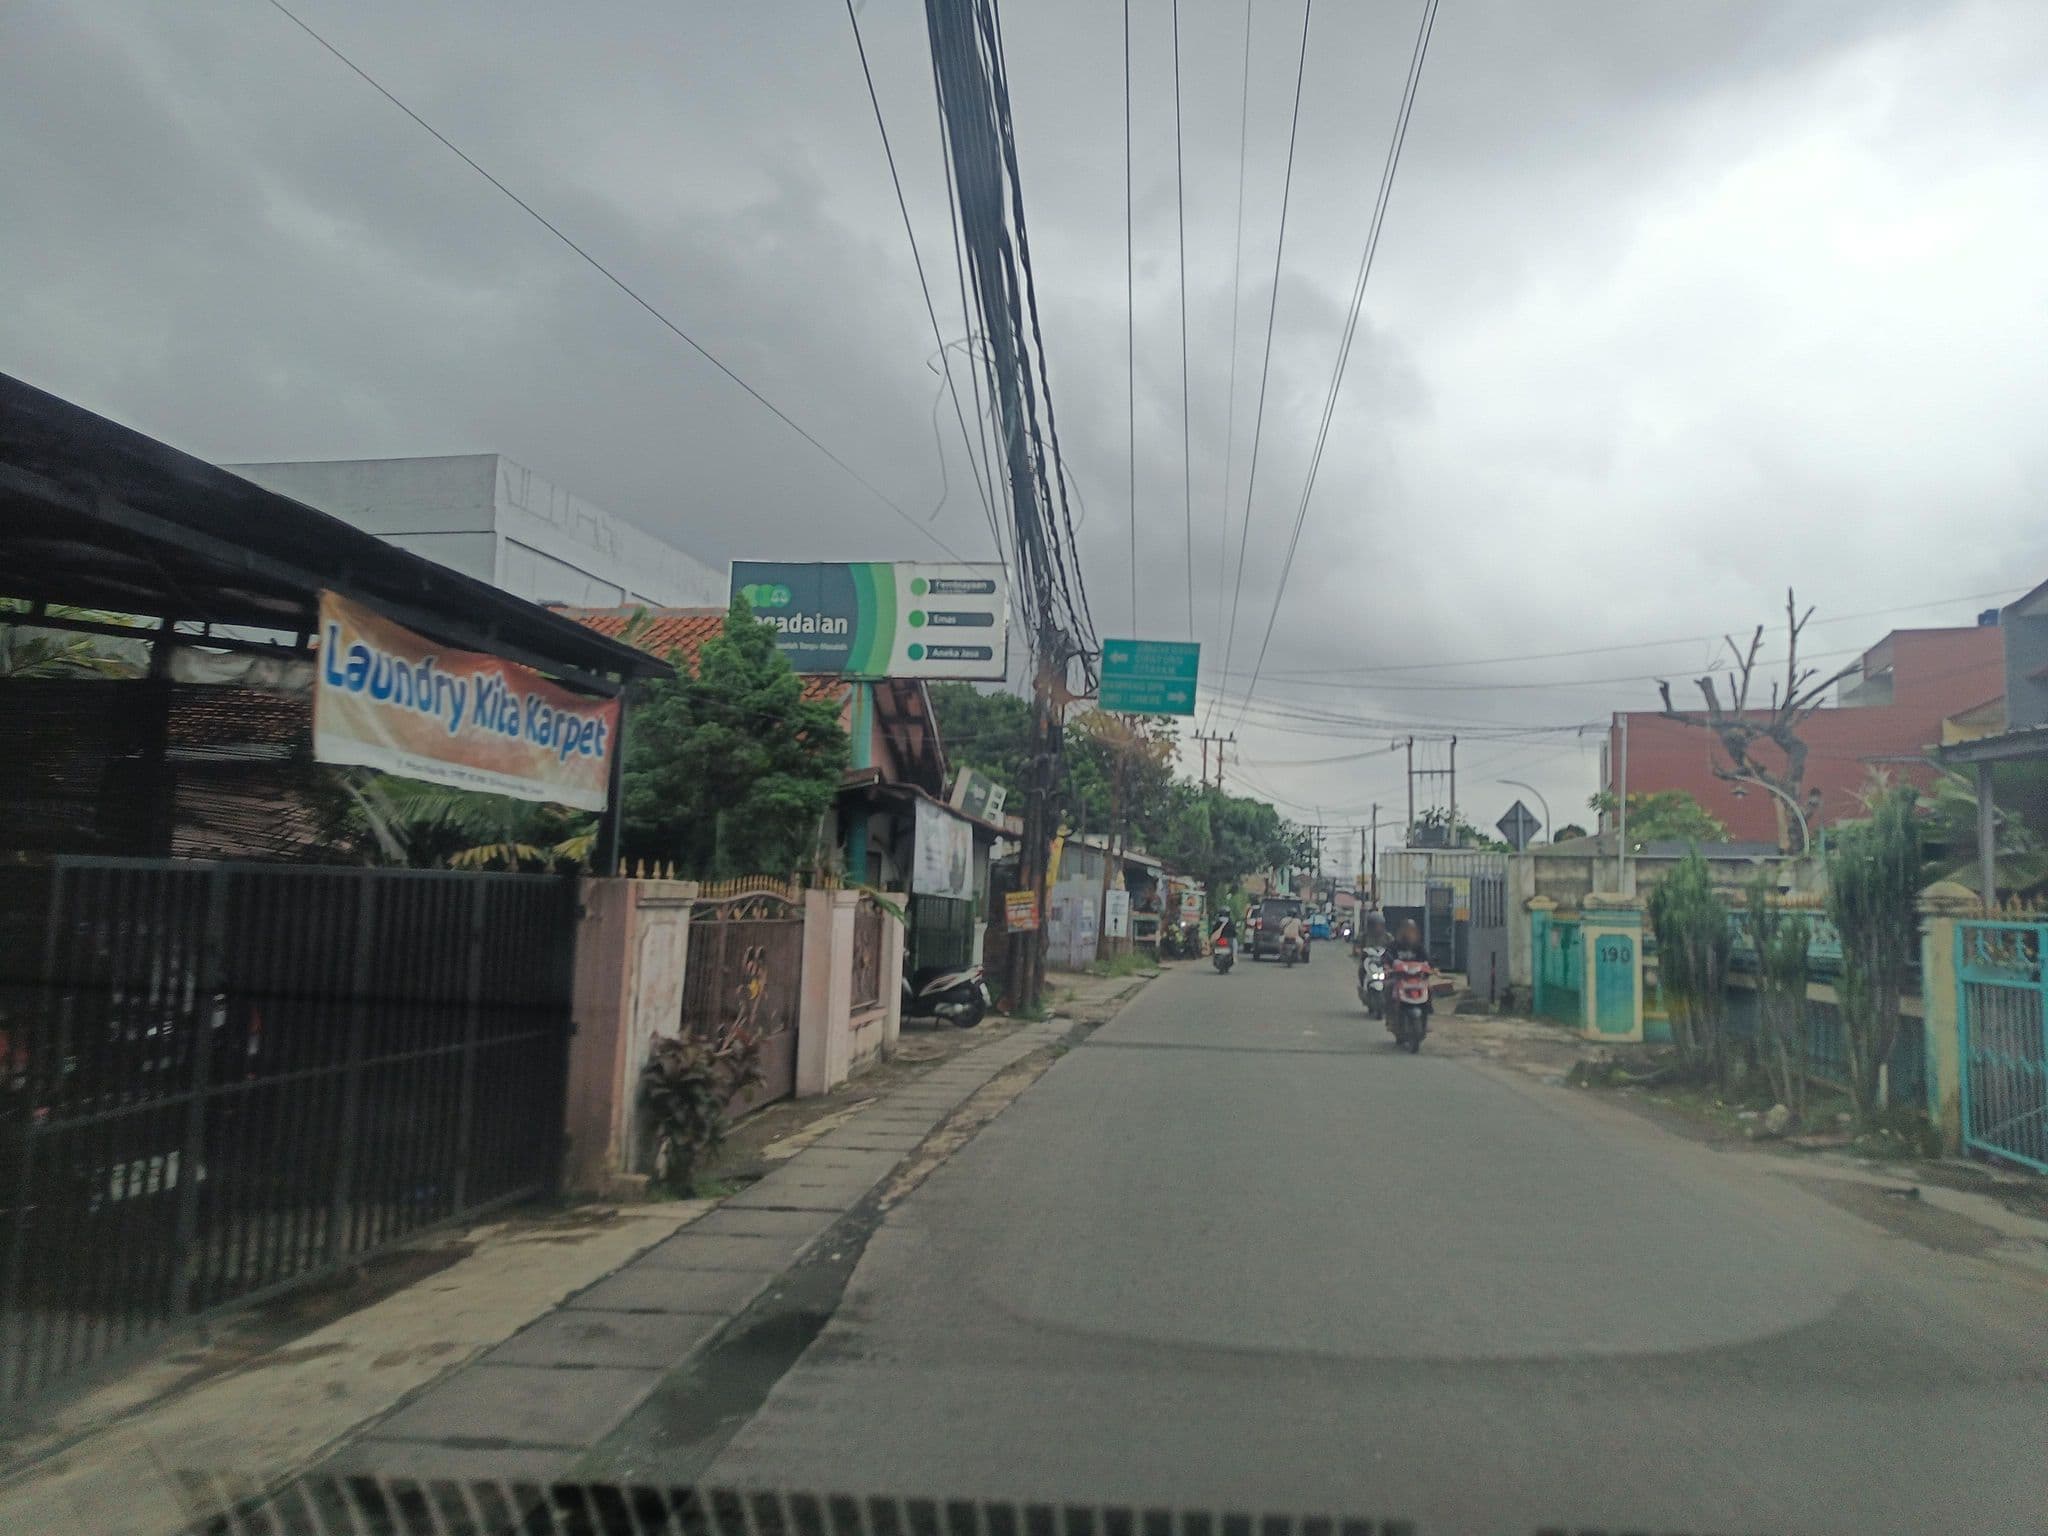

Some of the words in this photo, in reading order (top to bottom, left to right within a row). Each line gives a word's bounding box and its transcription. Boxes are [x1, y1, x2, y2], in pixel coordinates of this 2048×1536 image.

[326, 623, 467, 734] Laundry
[474, 675, 520, 737] Kita
[525, 695, 606, 761] Karpet
[1601, 945, 1632, 963] 190
